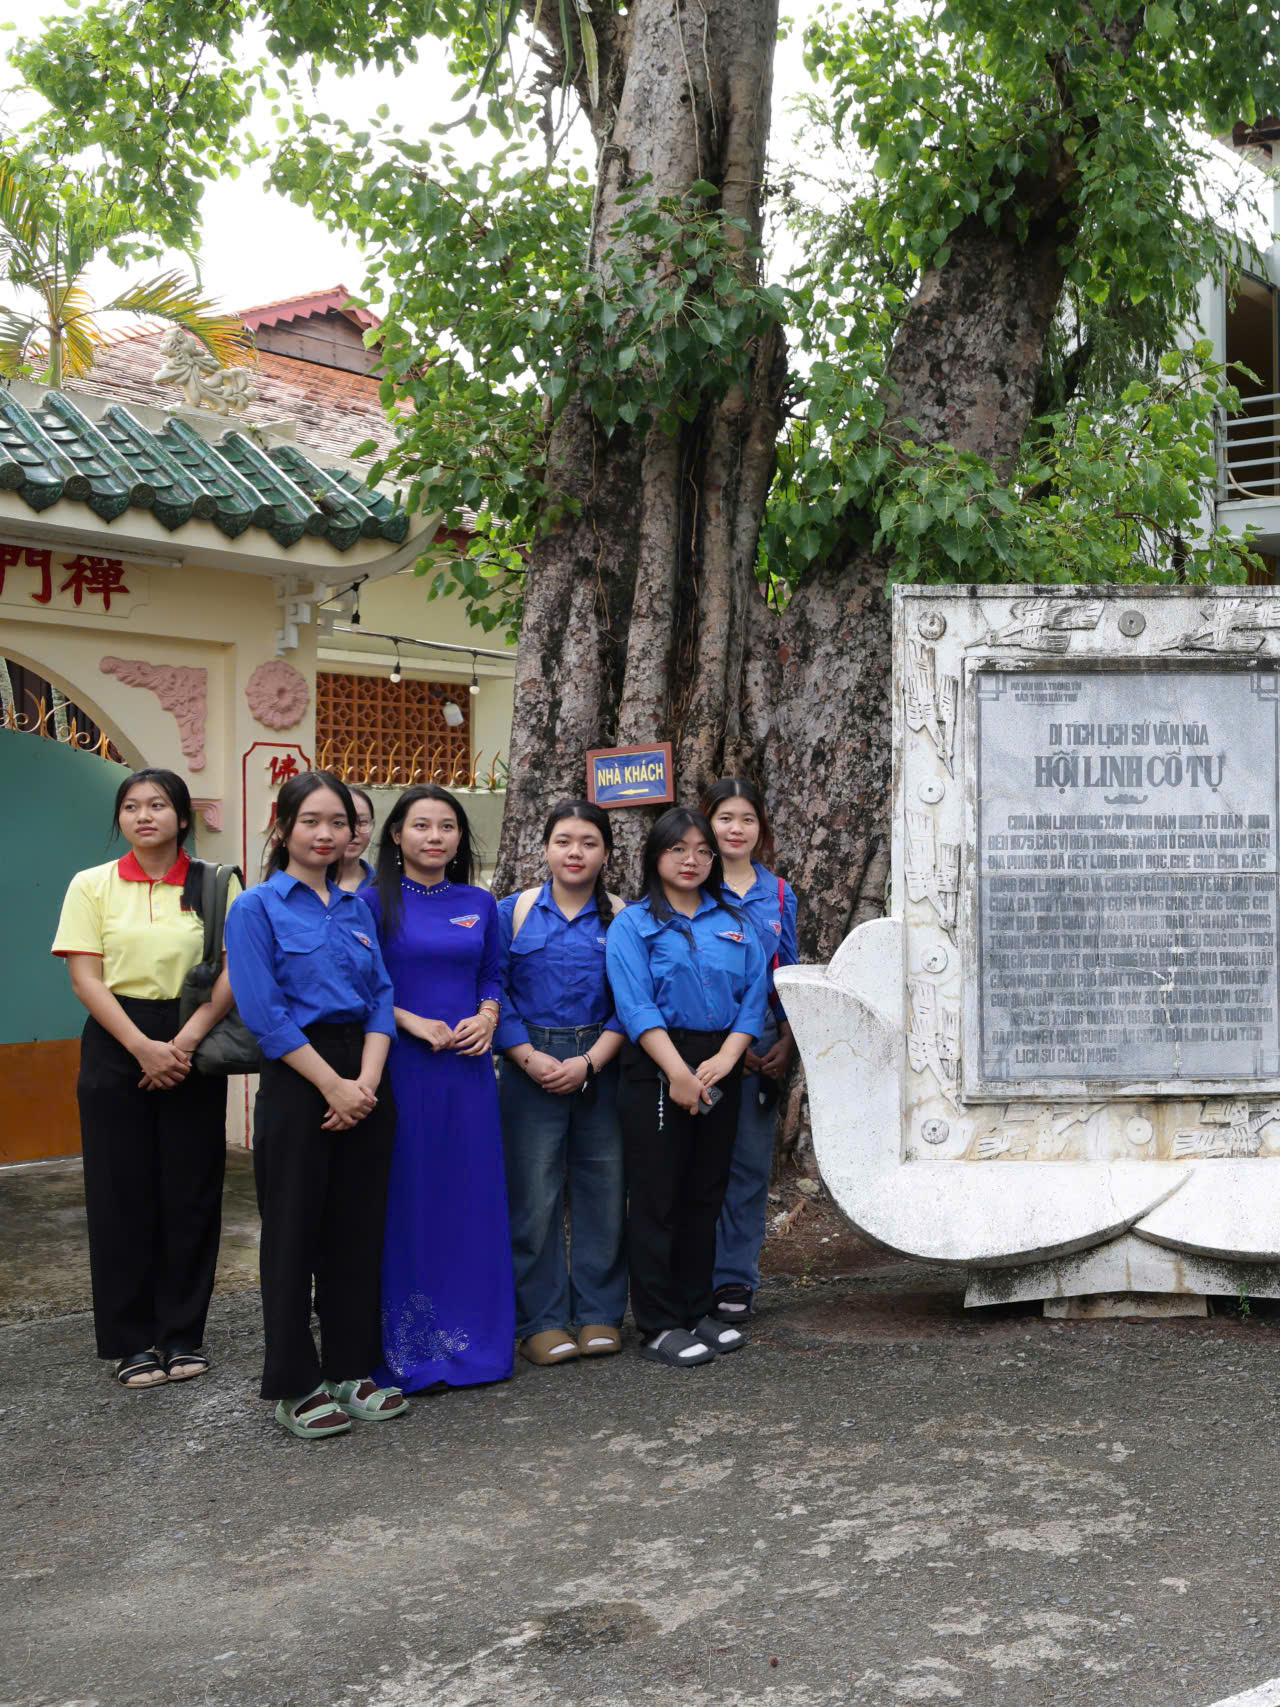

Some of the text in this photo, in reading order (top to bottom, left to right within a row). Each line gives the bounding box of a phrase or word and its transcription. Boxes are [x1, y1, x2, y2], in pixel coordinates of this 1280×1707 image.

[1049, 718, 1208, 749] DI TÍCH LỊCH SỬ VĂN HÓA
[597, 760, 664, 787] NHÀ KHÁCH
[1034, 745, 1225, 793] HỘI LINH CỔ TỰ
